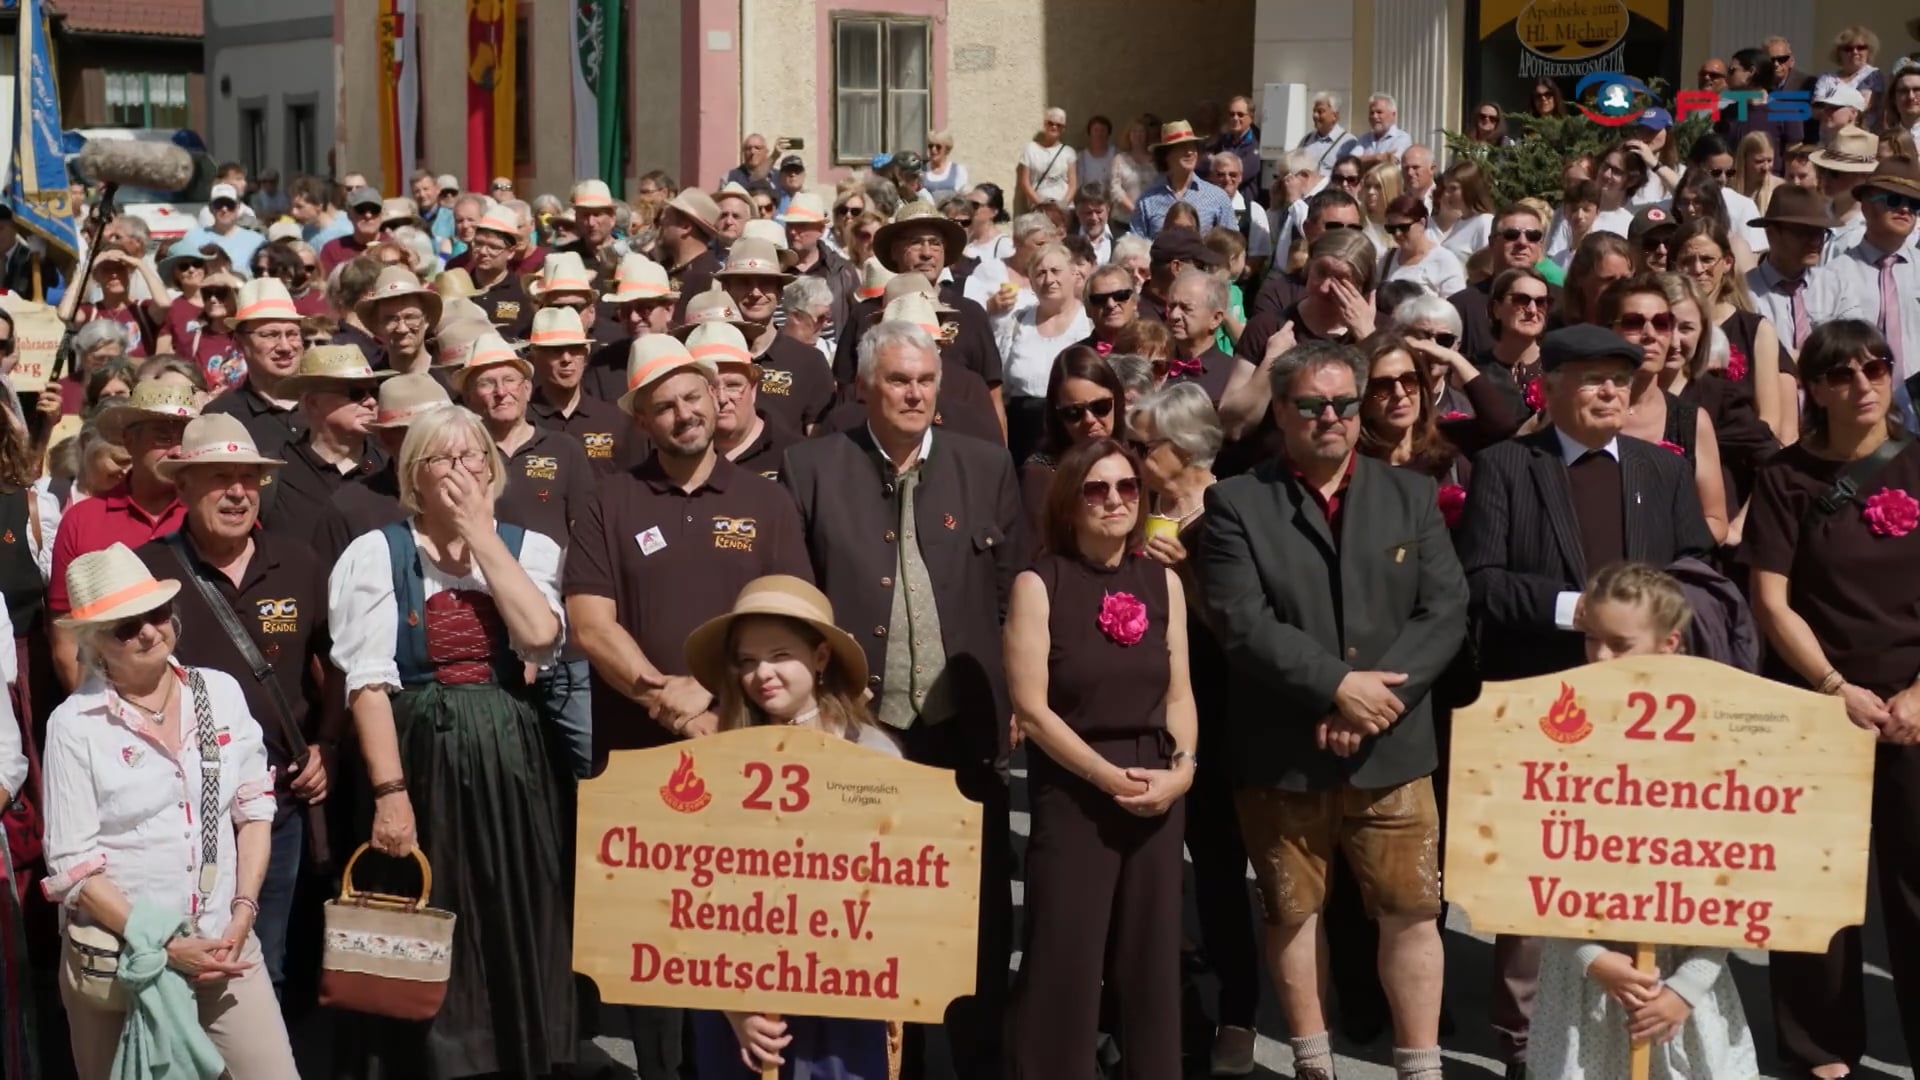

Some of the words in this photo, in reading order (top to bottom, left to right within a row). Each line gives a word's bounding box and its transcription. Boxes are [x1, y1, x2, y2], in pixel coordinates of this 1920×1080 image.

[1526, 24, 1549, 42] Hl.
[1556, 20, 1619, 41] Michael
[1527, 1, 1588, 21] Apotheke
[1592, 4, 1619, 15] zum
[1518, 41, 1625, 78] APOTHEKENKOSMETIK
[1624, 691, 1697, 743] 22
[741, 761, 811, 813] 23
[1521, 760, 1804, 815] Kirchenchor
[600, 825, 950, 889] Chorgemeinschaft
[1540, 809, 1778, 872] Übersaxen
[669, 888, 799, 936] Rendel
[808, 899, 874, 941] e.V.
[1527, 875, 1774, 944] Vorarlberg
[629, 942, 900, 1000] Deutschland
